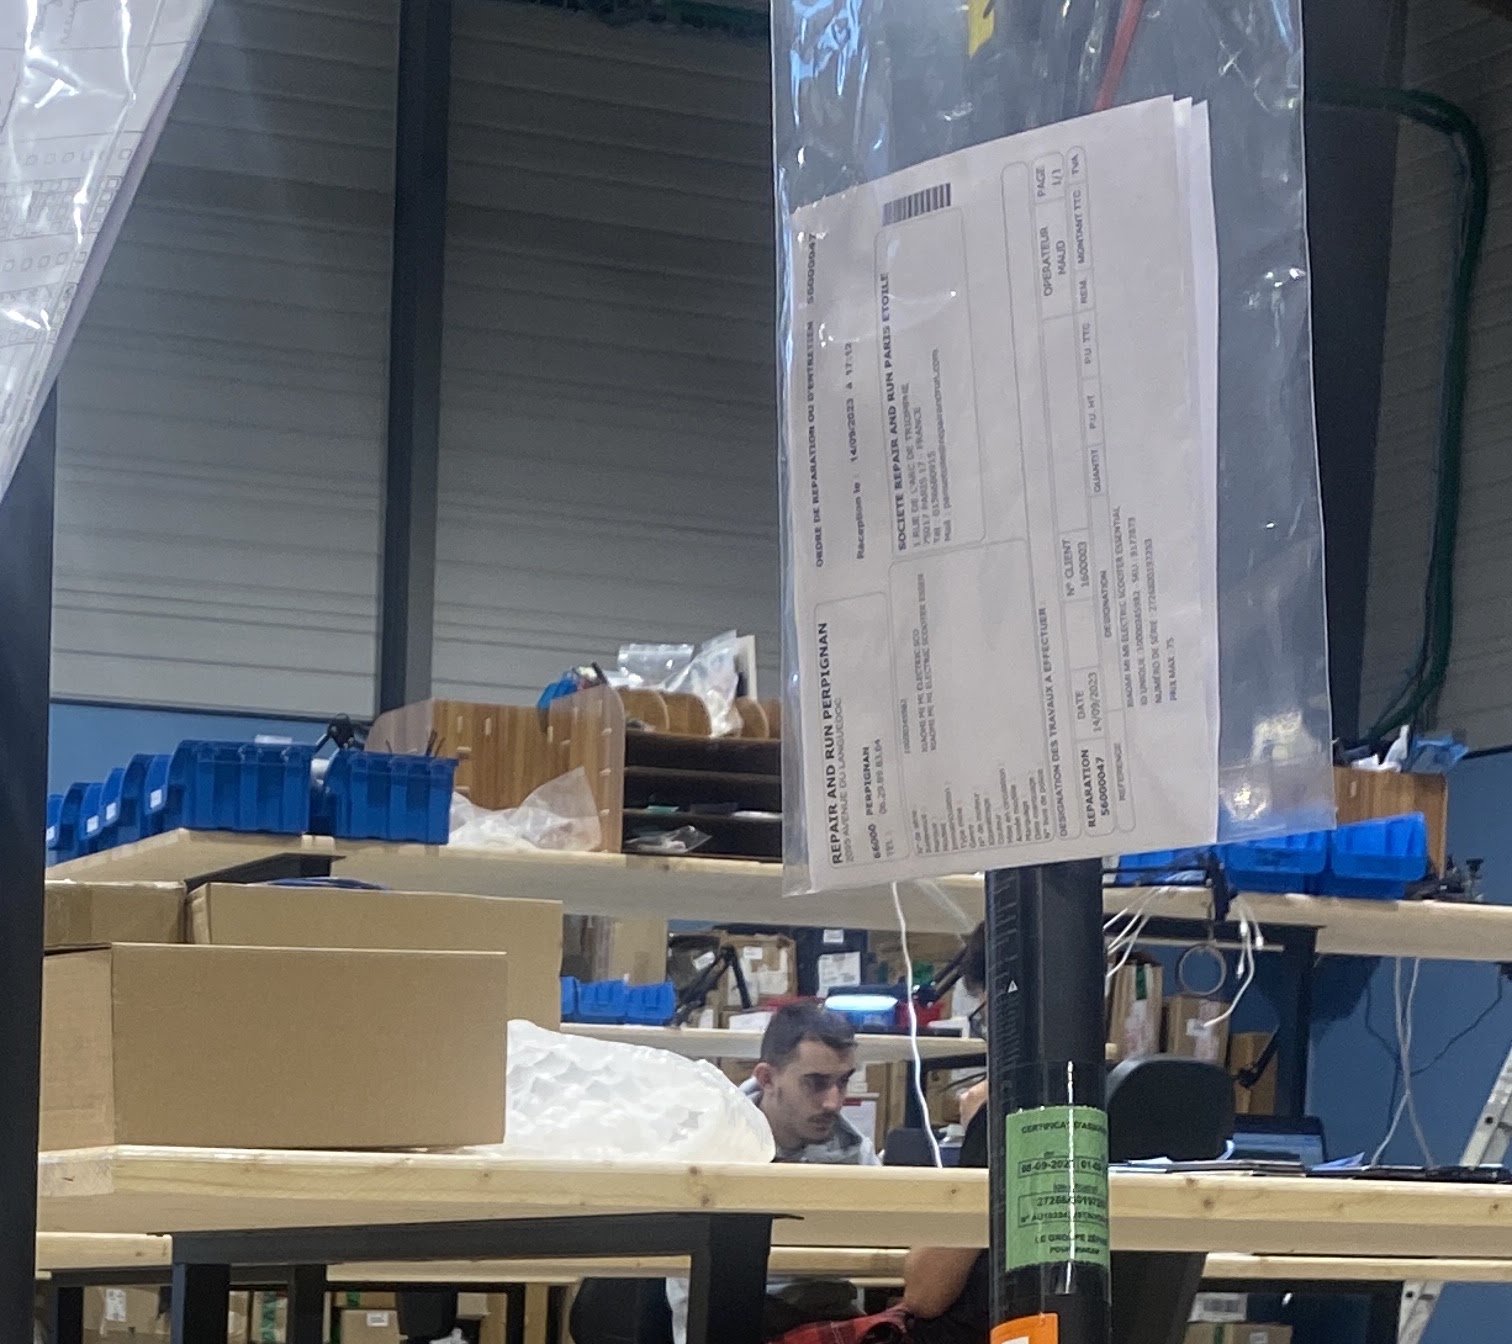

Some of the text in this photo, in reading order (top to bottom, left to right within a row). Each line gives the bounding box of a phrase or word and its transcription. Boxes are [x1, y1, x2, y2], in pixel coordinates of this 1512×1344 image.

[1035, 167, 1054, 296] OPERATEUR PAGE
[1074, 214, 1085, 264] MONTANT
[1055, 240, 1067, 275] MAUD
[807, 405, 815, 422] OU
[880, 273, 907, 551] SOCIETE REPAIR AND RUN PARIS ETOILE
[809, 426, 819, 503] REPARATION
[813, 508, 821, 523] DE
[919, 477, 928, 510] PARIS
[814, 527, 823, 567] ORDRE
[912, 516, 920, 538] RUE
[1062, 540, 1074, 579] CLIENT
[1038, 608, 1052, 672] EFFECTUER
[1078, 542, 1110, 816] 56000047 14/09/2023 1600003
[1045, 686, 1058, 737] TRAVAUX
[1075, 691, 1086, 719] DATE
[817, 623, 843, 864] REPAIR AND RUN PERPIGNAN
[1050, 740, 1060, 761] DES
[838, 772, 846, 788] DU
[862, 747, 882, 858] 66000 PERPIGNAN
[1053, 765, 1068, 837] DESIGNATION
[1080, 749, 1096, 827] REPARATION
[840, 792, 850, 835] AVENUE
